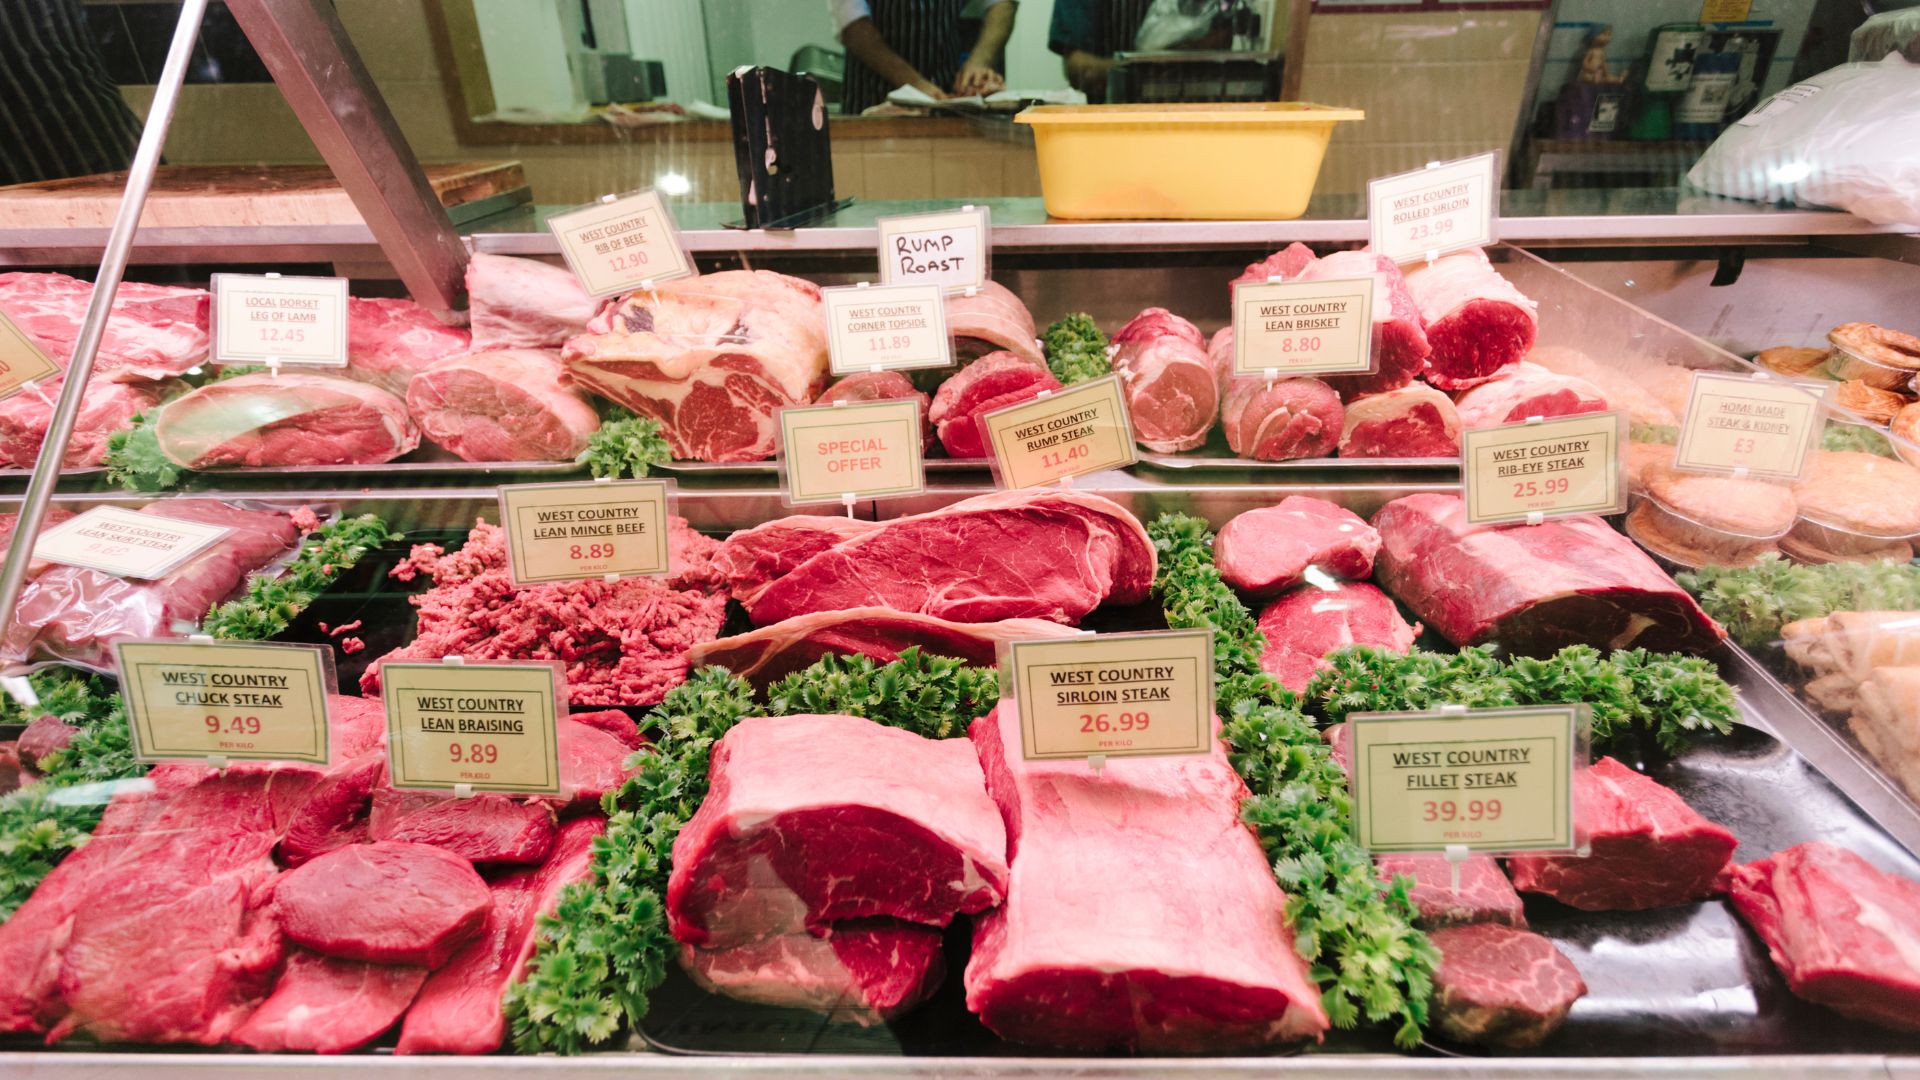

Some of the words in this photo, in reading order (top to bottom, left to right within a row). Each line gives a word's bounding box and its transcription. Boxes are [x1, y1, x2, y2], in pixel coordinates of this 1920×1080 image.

[1394, 196, 1419, 208] WEST
[1424, 184, 1470, 202] COUNTRY
[1394, 208, 1430, 222] ROLLED
[1433, 198, 1469, 214] SIRLOIN
[580, 229, 605, 242] WEST
[604, 216, 647, 235] COUNTRY
[1410, 219, 1453, 240] 23.99
[594, 244, 610, 253] RIB
[610, 240, 622, 250] OF
[624, 233, 645, 246] BEEF
[896, 235, 953, 256] RUMP
[609, 251, 648, 272] 12.90
[900, 256, 964, 276] ROAST
[246, 297, 276, 306] LOCAL
[280, 298, 319, 308] DORSET
[849, 308, 876, 318] WEST
[878, 305, 922, 316] COUNTRY
[1260, 305, 1290, 316] WEST
[1294, 302, 1347, 314] COUNTRY
[251, 311, 268, 320] LEG
[272, 312, 284, 320] OF
[288, 312, 316, 322] LAMB
[848, 322, 885, 332] CORNER
[889, 318, 926, 328] TOPSIDE
[1266, 320, 1292, 330] LEAN
[1296, 318, 1340, 328] BRISKET
[260, 328, 304, 342] 12.45
[870, 336, 911, 351] 11.89
[1282, 336, 1320, 352] 8.80
[1720, 401, 1752, 413] HOME
[1754, 404, 1786, 417] MADE
[1015, 424, 1045, 439] WEST
[1047, 408, 1098, 430] COUNTRY
[1707, 416, 1740, 428] STEAK
[1742, 422, 1750, 430] &
[1753, 422, 1791, 434] KIDNEY
[818, 438, 888, 456] SPECIAL
[1027, 435, 1060, 451] RUMP
[1062, 425, 1094, 440] STEAK
[1734, 438, 1755, 454] £3
[1042, 444, 1088, 468] 11.40
[1493, 448, 1526, 460] WEST
[1530, 440, 1590, 456] COUNTRY
[827, 456, 882, 472] OFFER
[1498, 462, 1544, 476] RIB-EYE
[1547, 456, 1584, 470] STEAK
[1513, 477, 1569, 498] 25.99
[538, 510, 574, 522] WEST
[578, 508, 638, 520] COUNTRY
[77, 528, 106, 539] LEAN
[108, 534, 138, 545] SKIRT
[138, 539, 176, 550] STEAK
[97, 521, 128, 532] WEST
[128, 528, 184, 542] COUNTRY
[534, 527, 566, 538] LEAN
[571, 525, 612, 536] MINCE
[616, 523, 645, 534] BEEF
[570, 543, 614, 560] 8.89
[162, 672, 207, 684] WEST
[211, 674, 288, 686] COUNTRY
[1050, 670, 1094, 684] WEST
[1098, 666, 1174, 682] COUNTRY
[176, 691, 228, 704] CHUCK
[234, 694, 282, 706] STEAK
[417, 696, 454, 710] WEST
[458, 698, 524, 711] COUNTRY
[1057, 690, 1117, 704] SIRLOIN
[1122, 687, 1170, 700] STEAK
[205, 715, 260, 734] 9.49
[421, 718, 454, 730] LEAN
[458, 720, 523, 732] BRAISING
[1080, 711, 1150, 733] 26.99
[450, 743, 498, 764] 9.89
[1393, 752, 1441, 766] WEST
[1446, 748, 1530, 764] COUNTRY
[1407, 774, 1459, 788] FILLET
[1464, 771, 1518, 786] STEAK
[1423, 799, 1502, 822] 39.99
